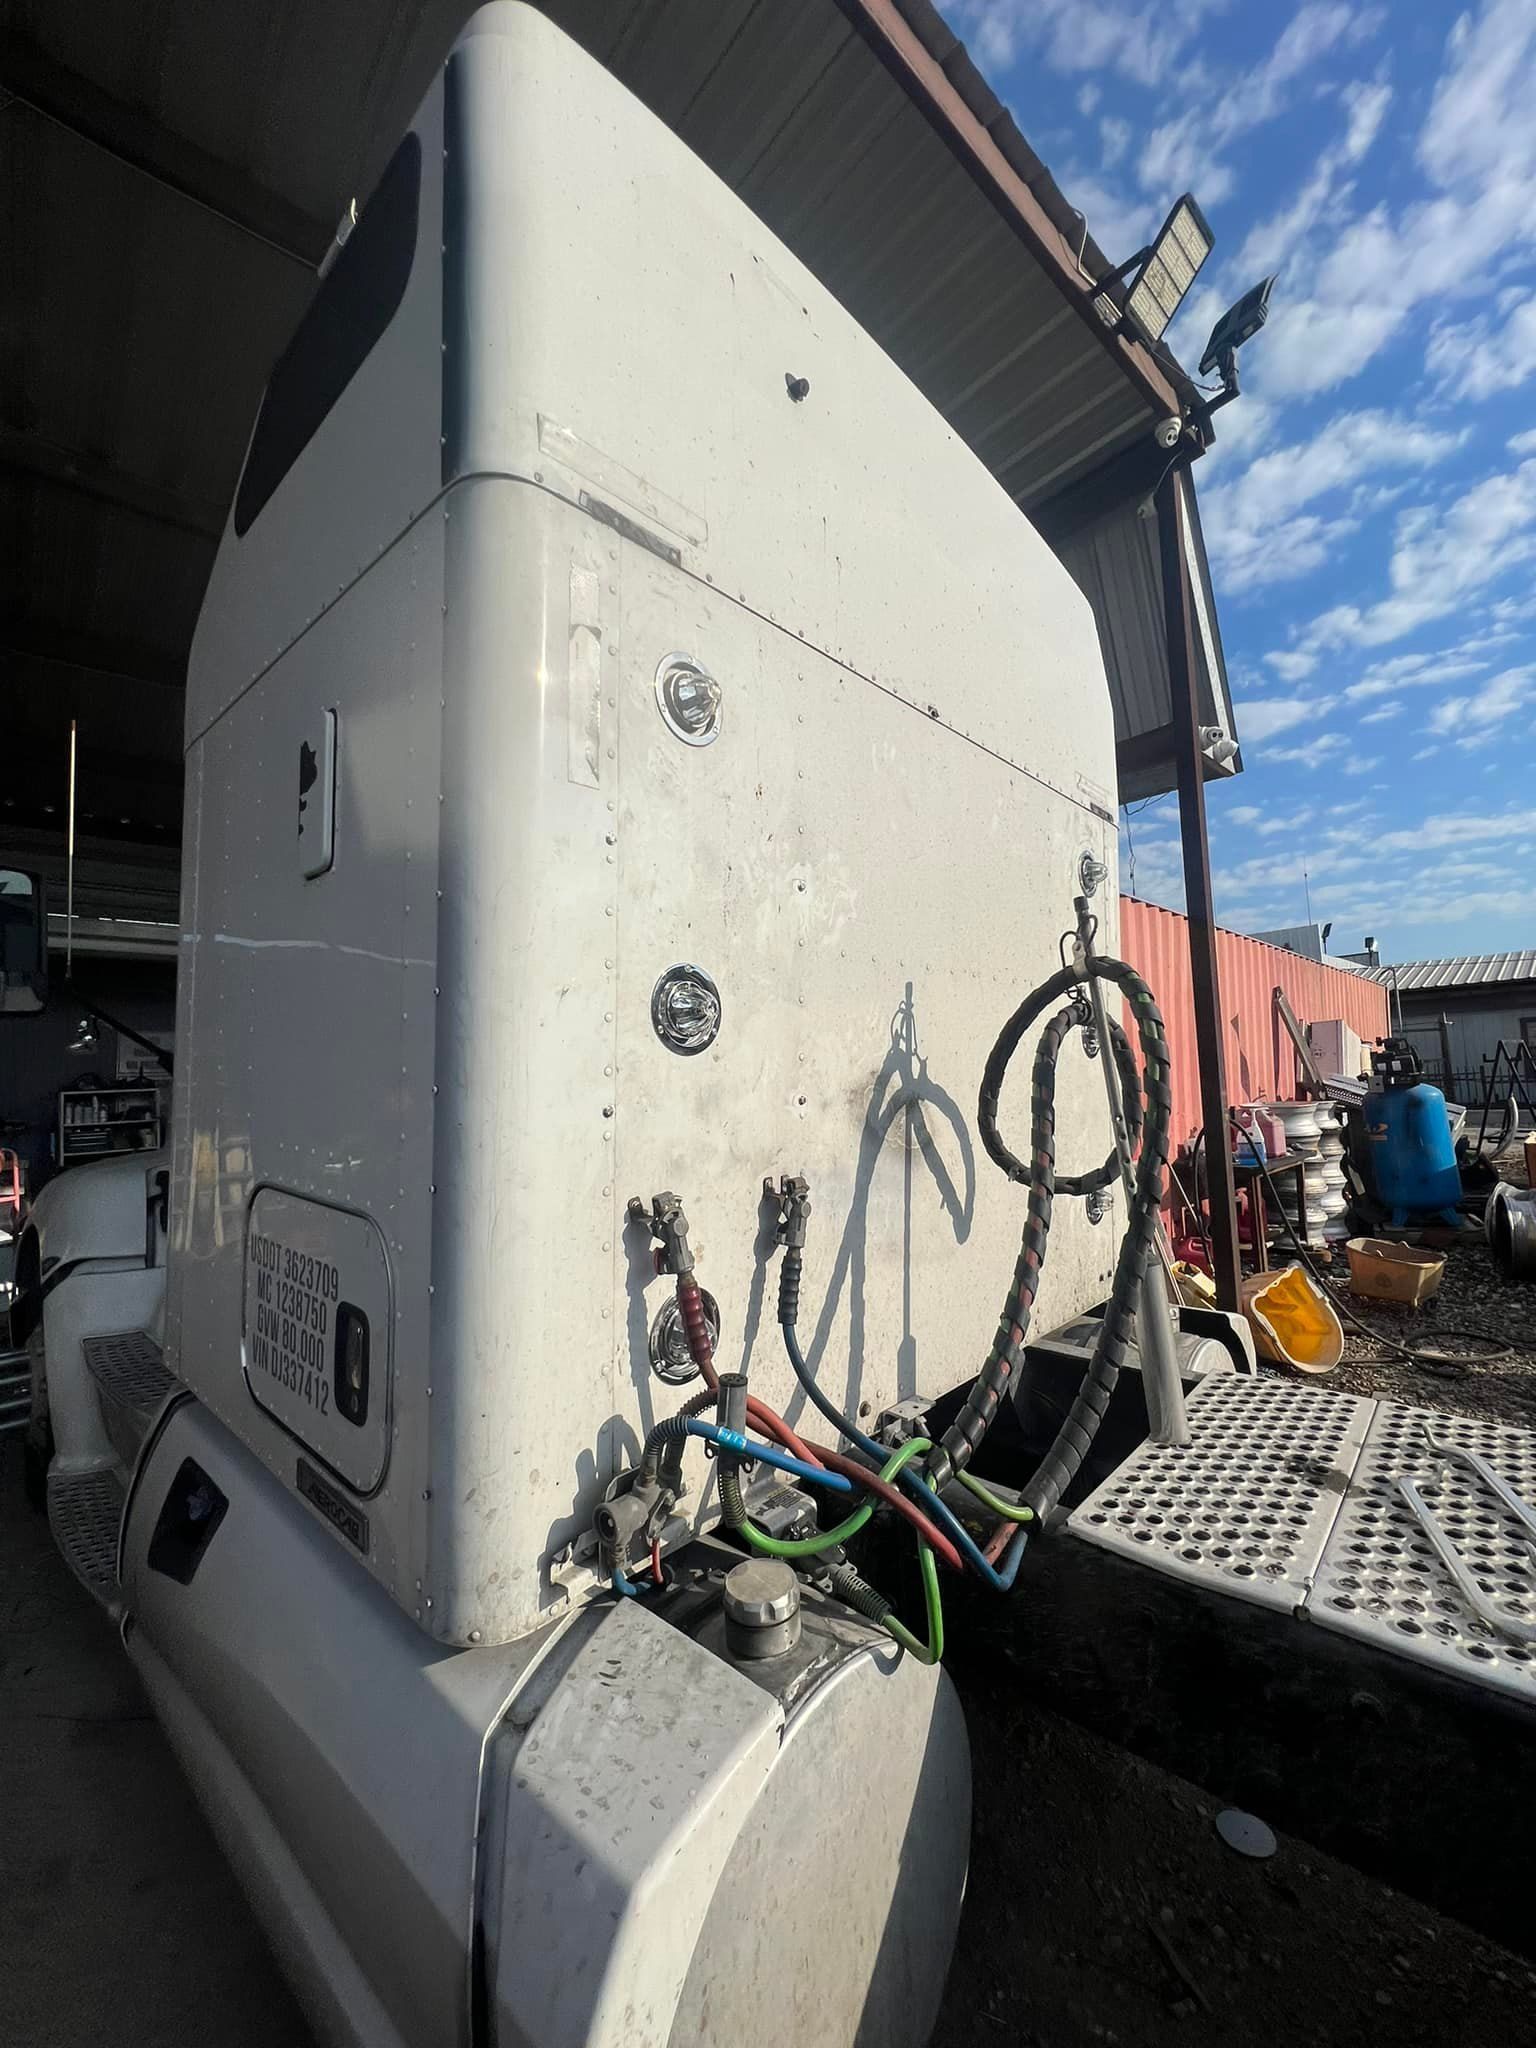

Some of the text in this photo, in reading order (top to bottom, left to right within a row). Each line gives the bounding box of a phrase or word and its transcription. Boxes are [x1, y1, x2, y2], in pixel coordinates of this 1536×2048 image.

[251, 1233, 339, 1302] USDOT 3623709
[257, 1269, 327, 1335] MC 1238750
[257, 1303, 280, 1343] GVW
[252, 1332, 329, 1416] VIN DJ337412
